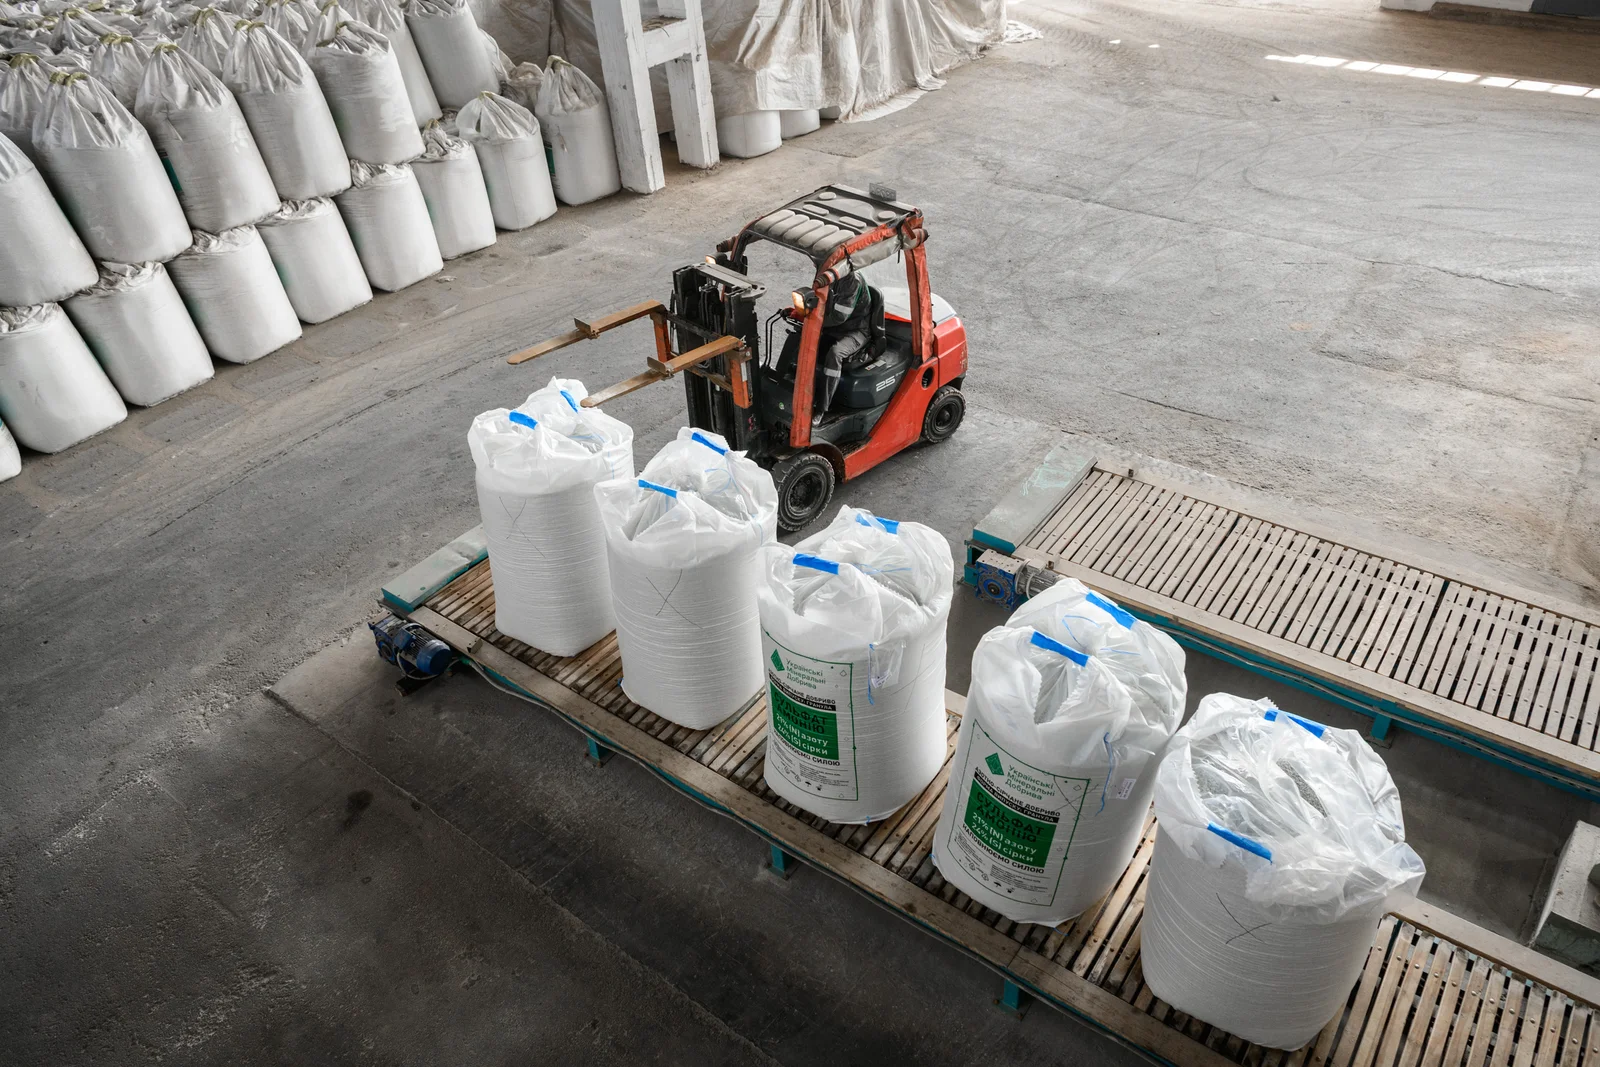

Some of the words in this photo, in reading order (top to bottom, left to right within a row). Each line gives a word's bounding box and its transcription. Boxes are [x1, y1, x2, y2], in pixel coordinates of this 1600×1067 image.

[876, 375, 896, 392] 25
[786, 658, 823, 677] Українські
[787, 666, 826, 684] Мінеральні
[787, 673, 817, 690] Добрива
[774, 691, 828, 726] СУЛЬФАТ
[806, 694, 836, 705] ДОБРИВО
[776, 703, 825, 734] АМОНІЮ
[789, 724, 800, 738] (N)
[801, 733, 829, 747] азоту
[791, 735, 802, 747] (S)
[802, 743, 828, 755] сірки
[812, 756, 841, 767] СИЛОЮ
[1007, 771, 1056, 797] Мінеральні
[1008, 764, 1054, 790] Українські
[1005, 779, 1043, 801] Добрива
[976, 791, 1045, 835] СУЛЬФАТ
[1023, 809, 1055, 823] ГРАНУЛА
[1025, 804, 1061, 817] ДОБРИВО
[972, 811, 989, 830] 21%
[989, 826, 1004, 841] (N)
[1004, 839, 1037, 855] азоту
[976, 805, 1037, 843] АМОНІЮ
[971, 822, 989, 840] 24%
[989, 837, 1002, 850] (S)
[1003, 847, 1034, 862] сірки
[1011, 861, 1045, 874] СИЛОЮ
